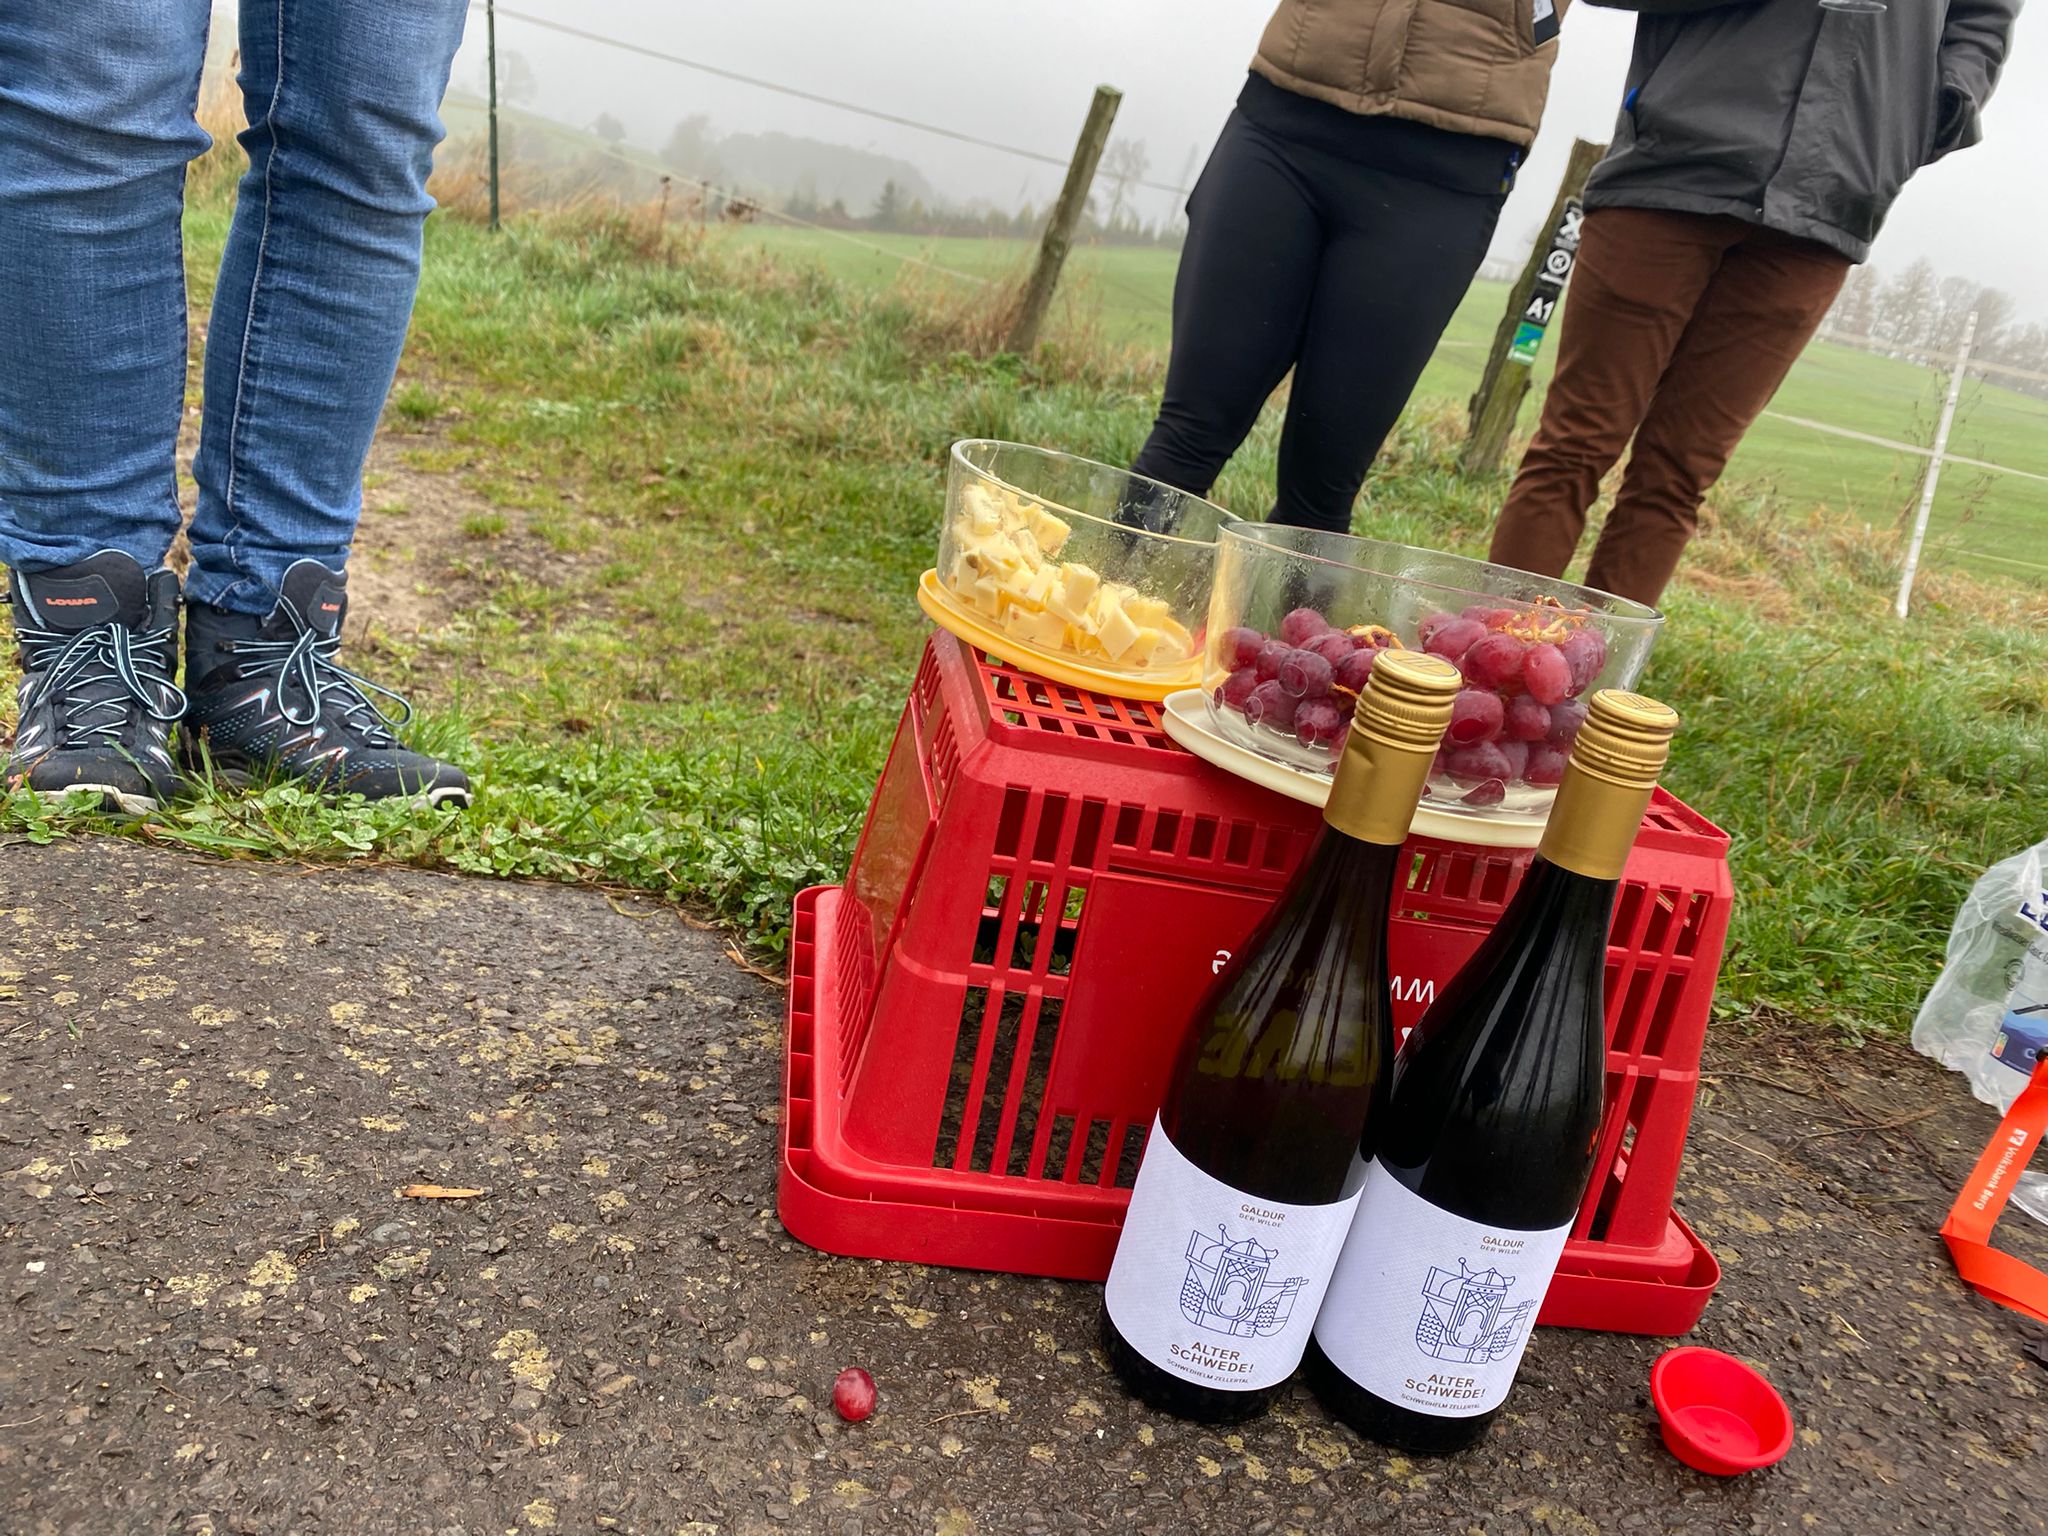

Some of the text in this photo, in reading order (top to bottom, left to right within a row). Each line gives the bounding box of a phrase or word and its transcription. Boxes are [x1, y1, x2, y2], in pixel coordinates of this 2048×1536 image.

[1525, 296, 1555, 322] A1
[1972, 1146, 2020, 1211] Volksbank Berg
[1238, 1212, 1281, 1228] DER WILDE
[1241, 1203, 1286, 1221] GALDUR
[1479, 1244, 1521, 1255] DER WILDE
[1482, 1235, 1525, 1248] GALDUR
[1170, 1343, 1254, 1373] SCHWEDE!
[1191, 1341, 1241, 1361] ALTER
[1166, 1358, 1213, 1379] SCHWEDHELM
[1405, 1378, 1486, 1399] SCHWEDE!
[1427, 1373, 1475, 1388] ALTER
[1401, 1393, 1448, 1409] SCHWEDHELM
